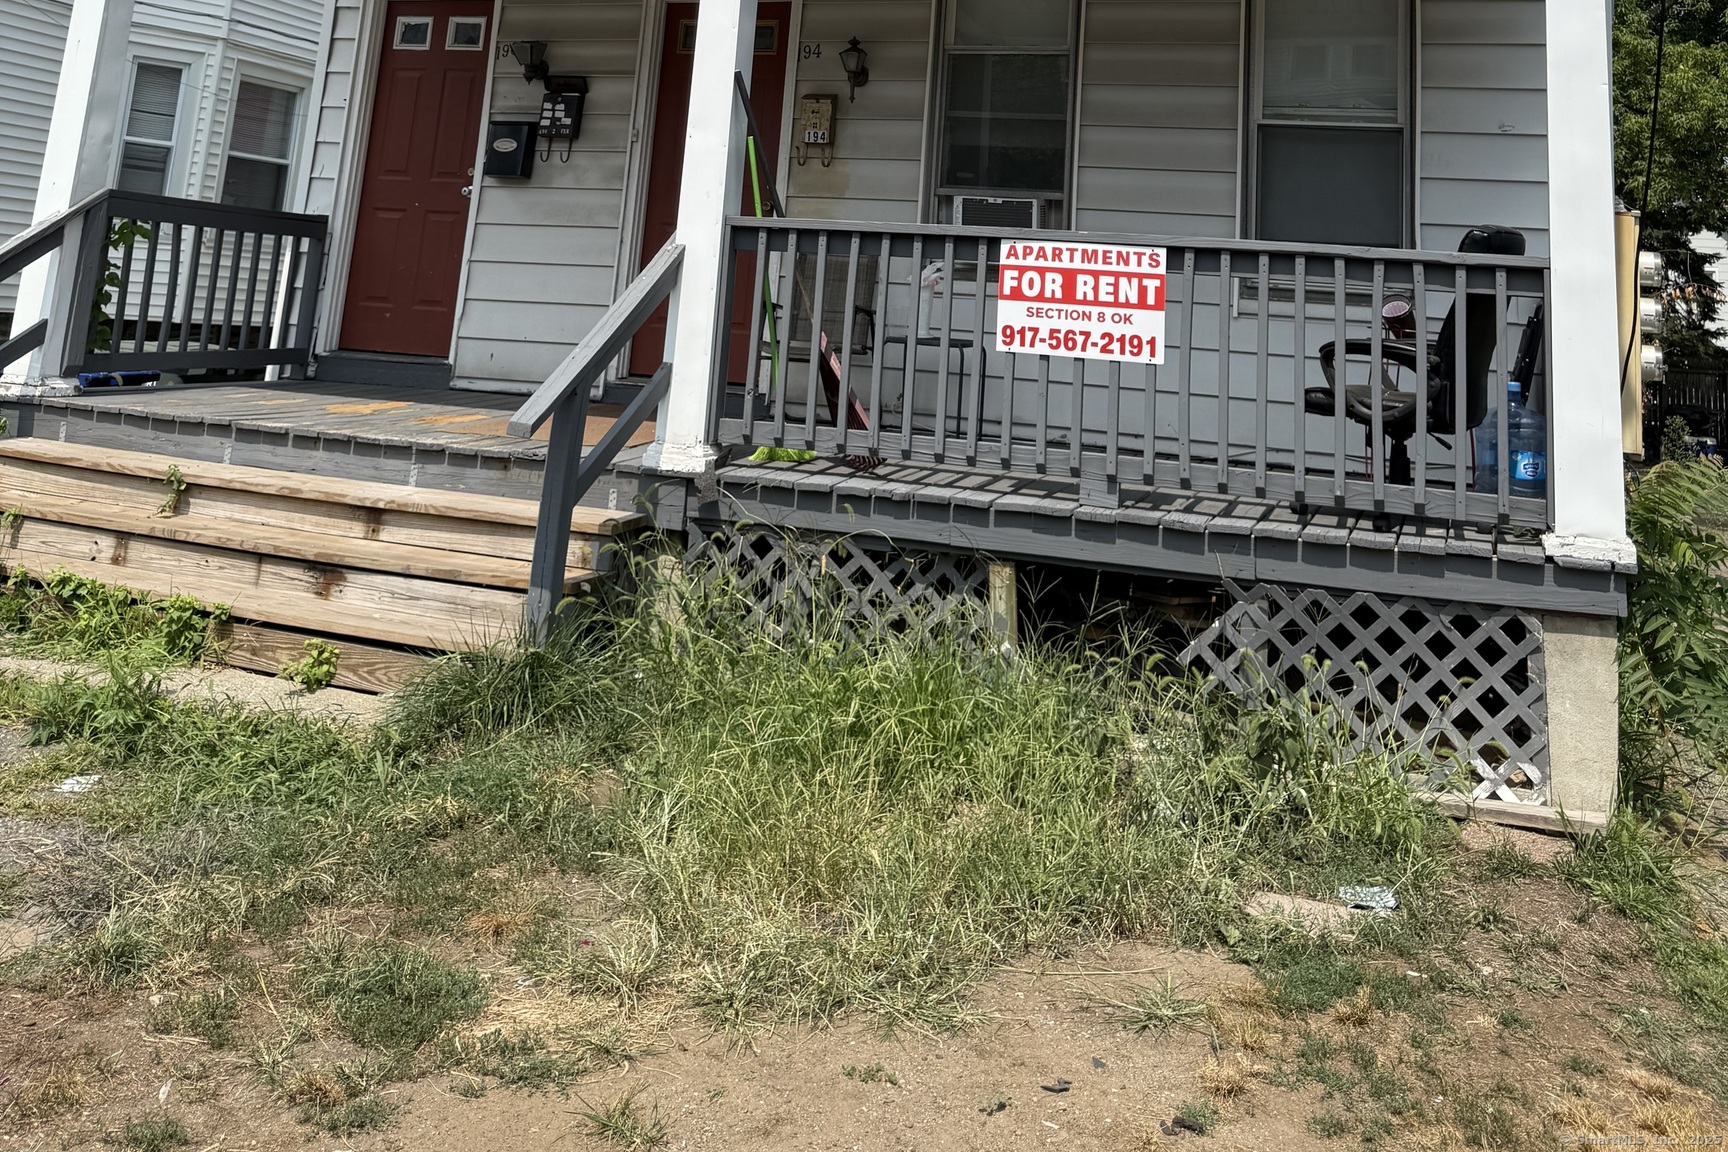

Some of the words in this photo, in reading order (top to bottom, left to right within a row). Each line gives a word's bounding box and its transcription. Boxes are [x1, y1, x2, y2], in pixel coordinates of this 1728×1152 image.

[496, 43, 511, 60] 19
[799, 43, 822, 61] 94
[807, 131, 826, 142] 194
[1005, 244, 1161, 268] APARTMENTS
[1003, 269, 1063, 299] FOR
[1075, 273, 1161, 306] RENT
[1026, 306, 1092, 322] SECTION
[1097, 311, 1106, 323] 8
[1111, 313, 1133, 325] OK
[1001, 324, 1156, 358] 917-567-2191
